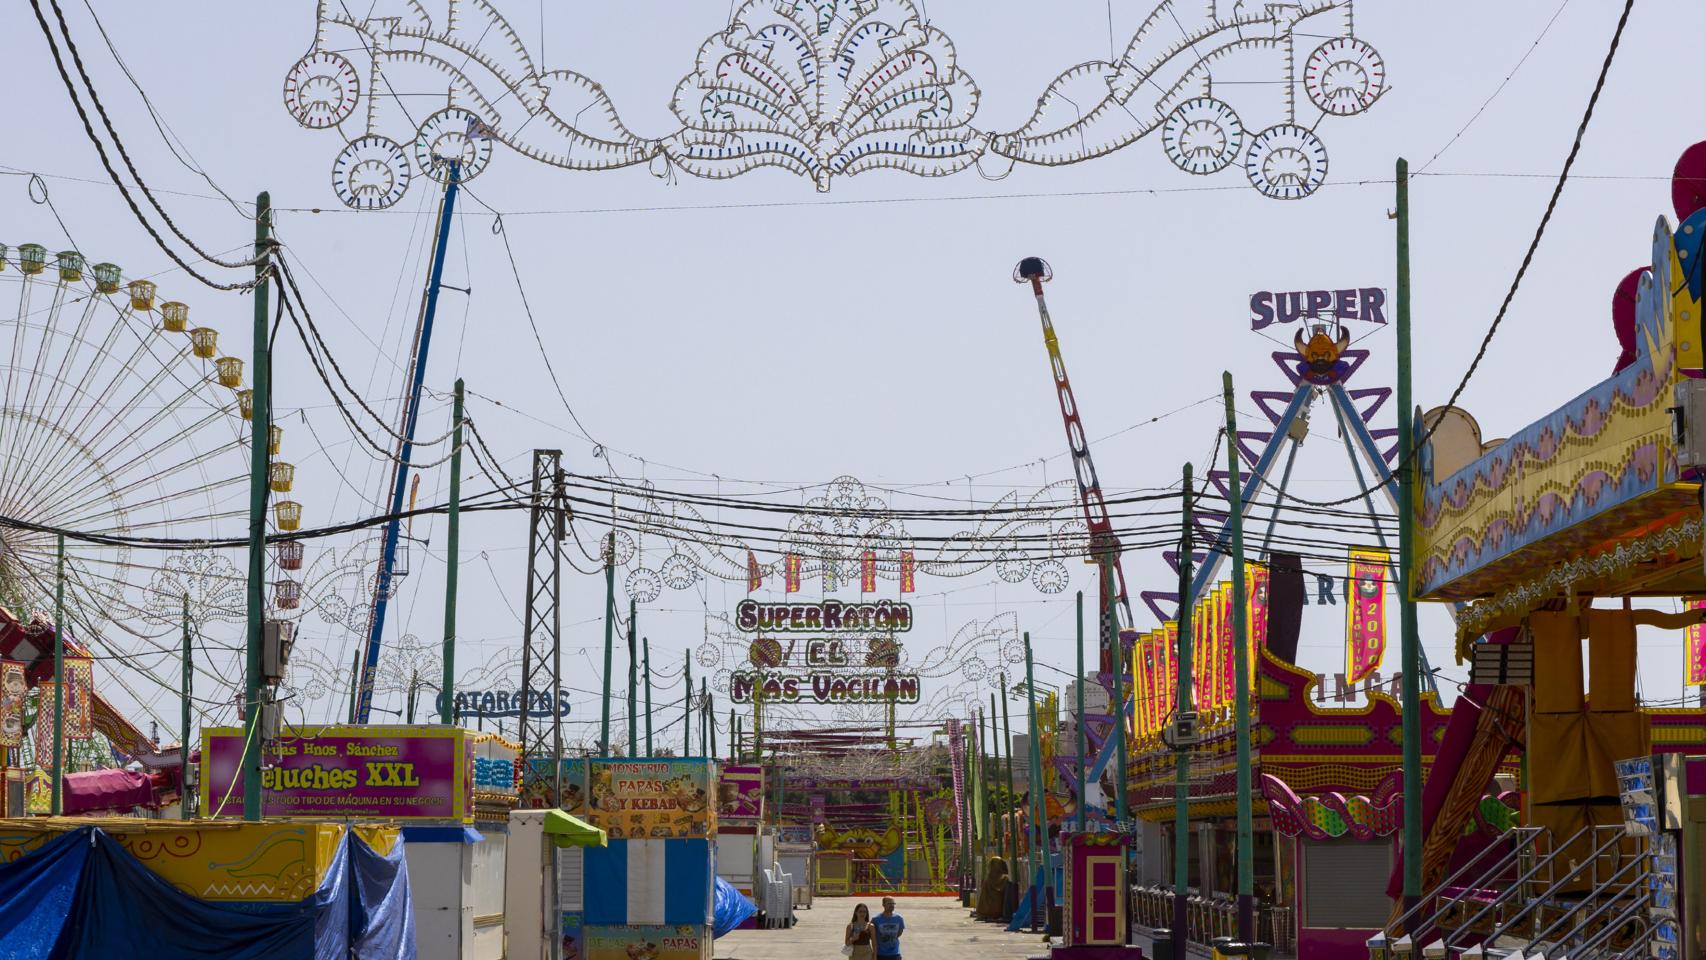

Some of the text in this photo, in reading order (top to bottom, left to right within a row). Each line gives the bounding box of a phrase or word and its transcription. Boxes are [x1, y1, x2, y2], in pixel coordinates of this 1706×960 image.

[1250, 287, 1386, 330] SUPER
[1367, 603, 1379, 665] 2000
[807, 640, 846, 666] EL
[346, 742, 399, 756] Sánchez
[608, 763, 669, 774] MONSTRUO
[262, 762, 420, 791] eluches XXL
[618, 780, 663, 793] PAPAS
[320, 797, 336, 806] DE
[380, 797, 392, 806] EN
[631, 799, 678, 810] KEBAB
[662, 938, 698, 950] PAPAS
